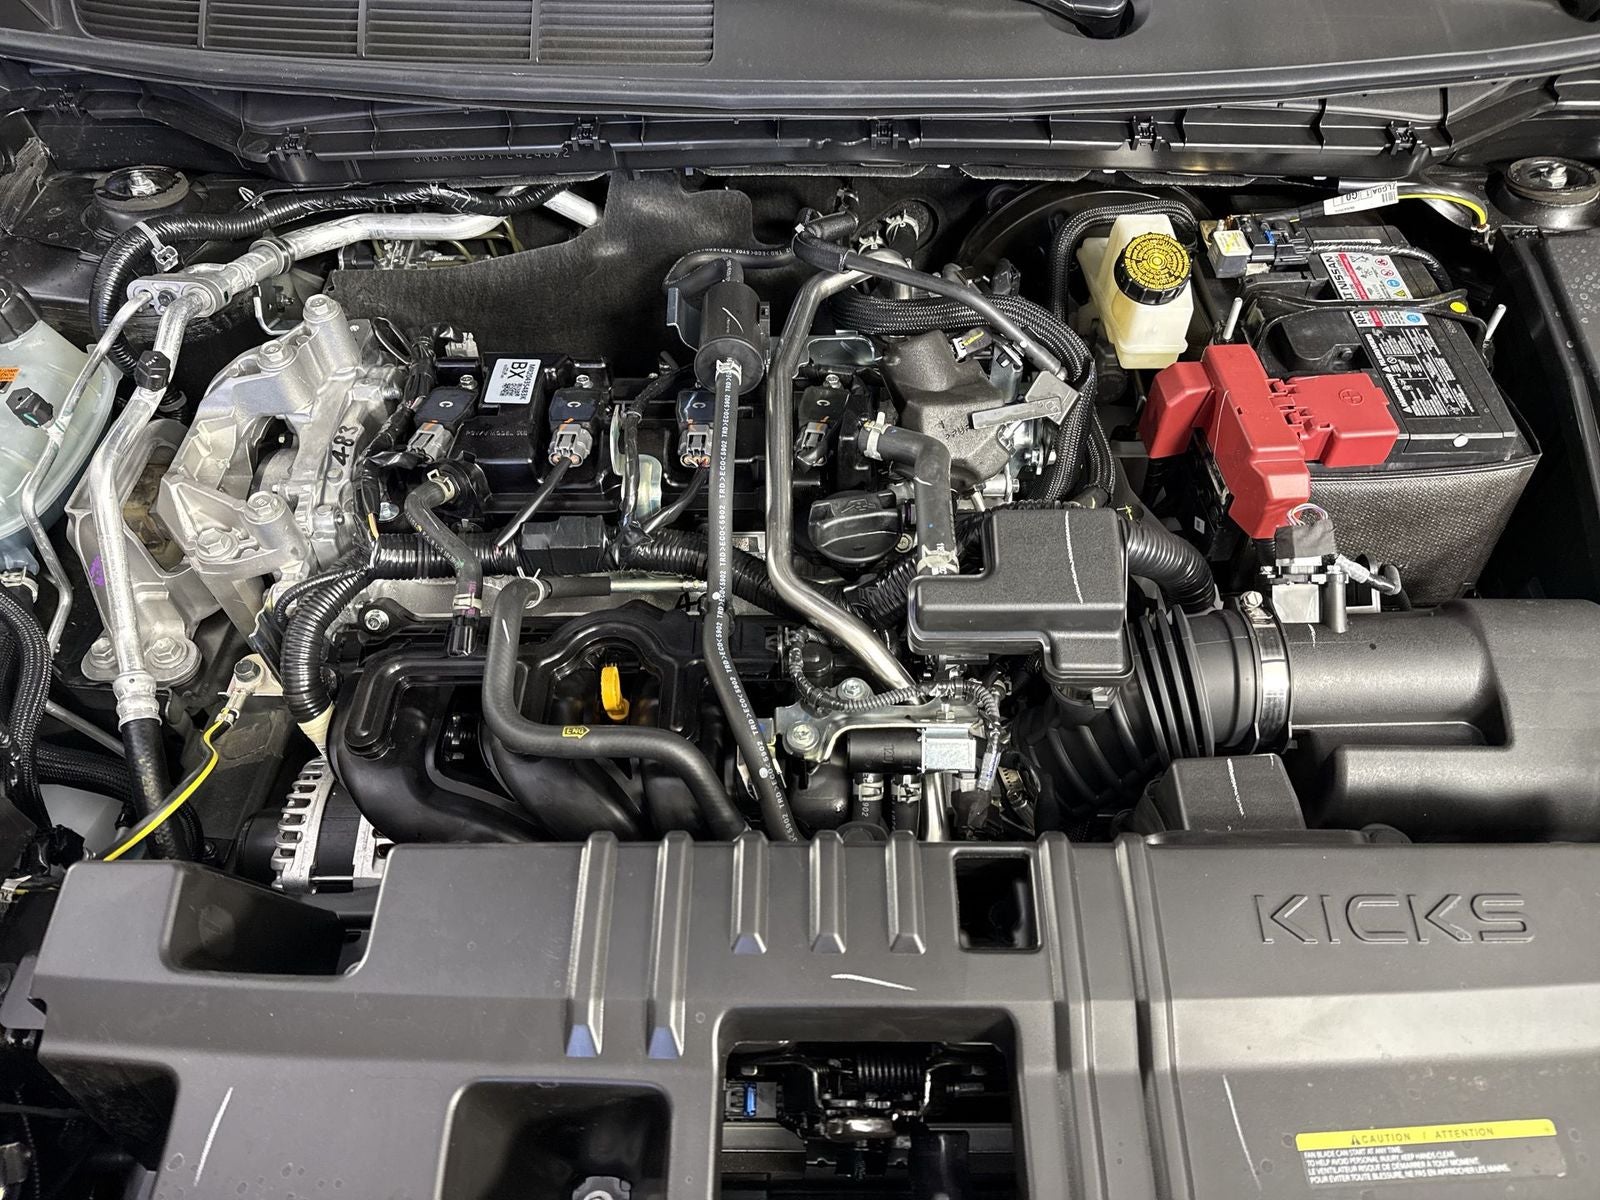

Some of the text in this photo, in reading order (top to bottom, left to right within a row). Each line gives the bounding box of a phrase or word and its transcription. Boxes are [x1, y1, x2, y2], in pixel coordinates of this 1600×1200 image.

[1324, 255, 1349, 290] NISSAN
[508, 361, 528, 379] BX
[565, 727, 584, 736] ENG
[1254, 893, 1535, 944] KICKS
[1361, 1133, 1411, 1145] CAUTION
[1435, 1127, 1494, 1139] ATTENTION
